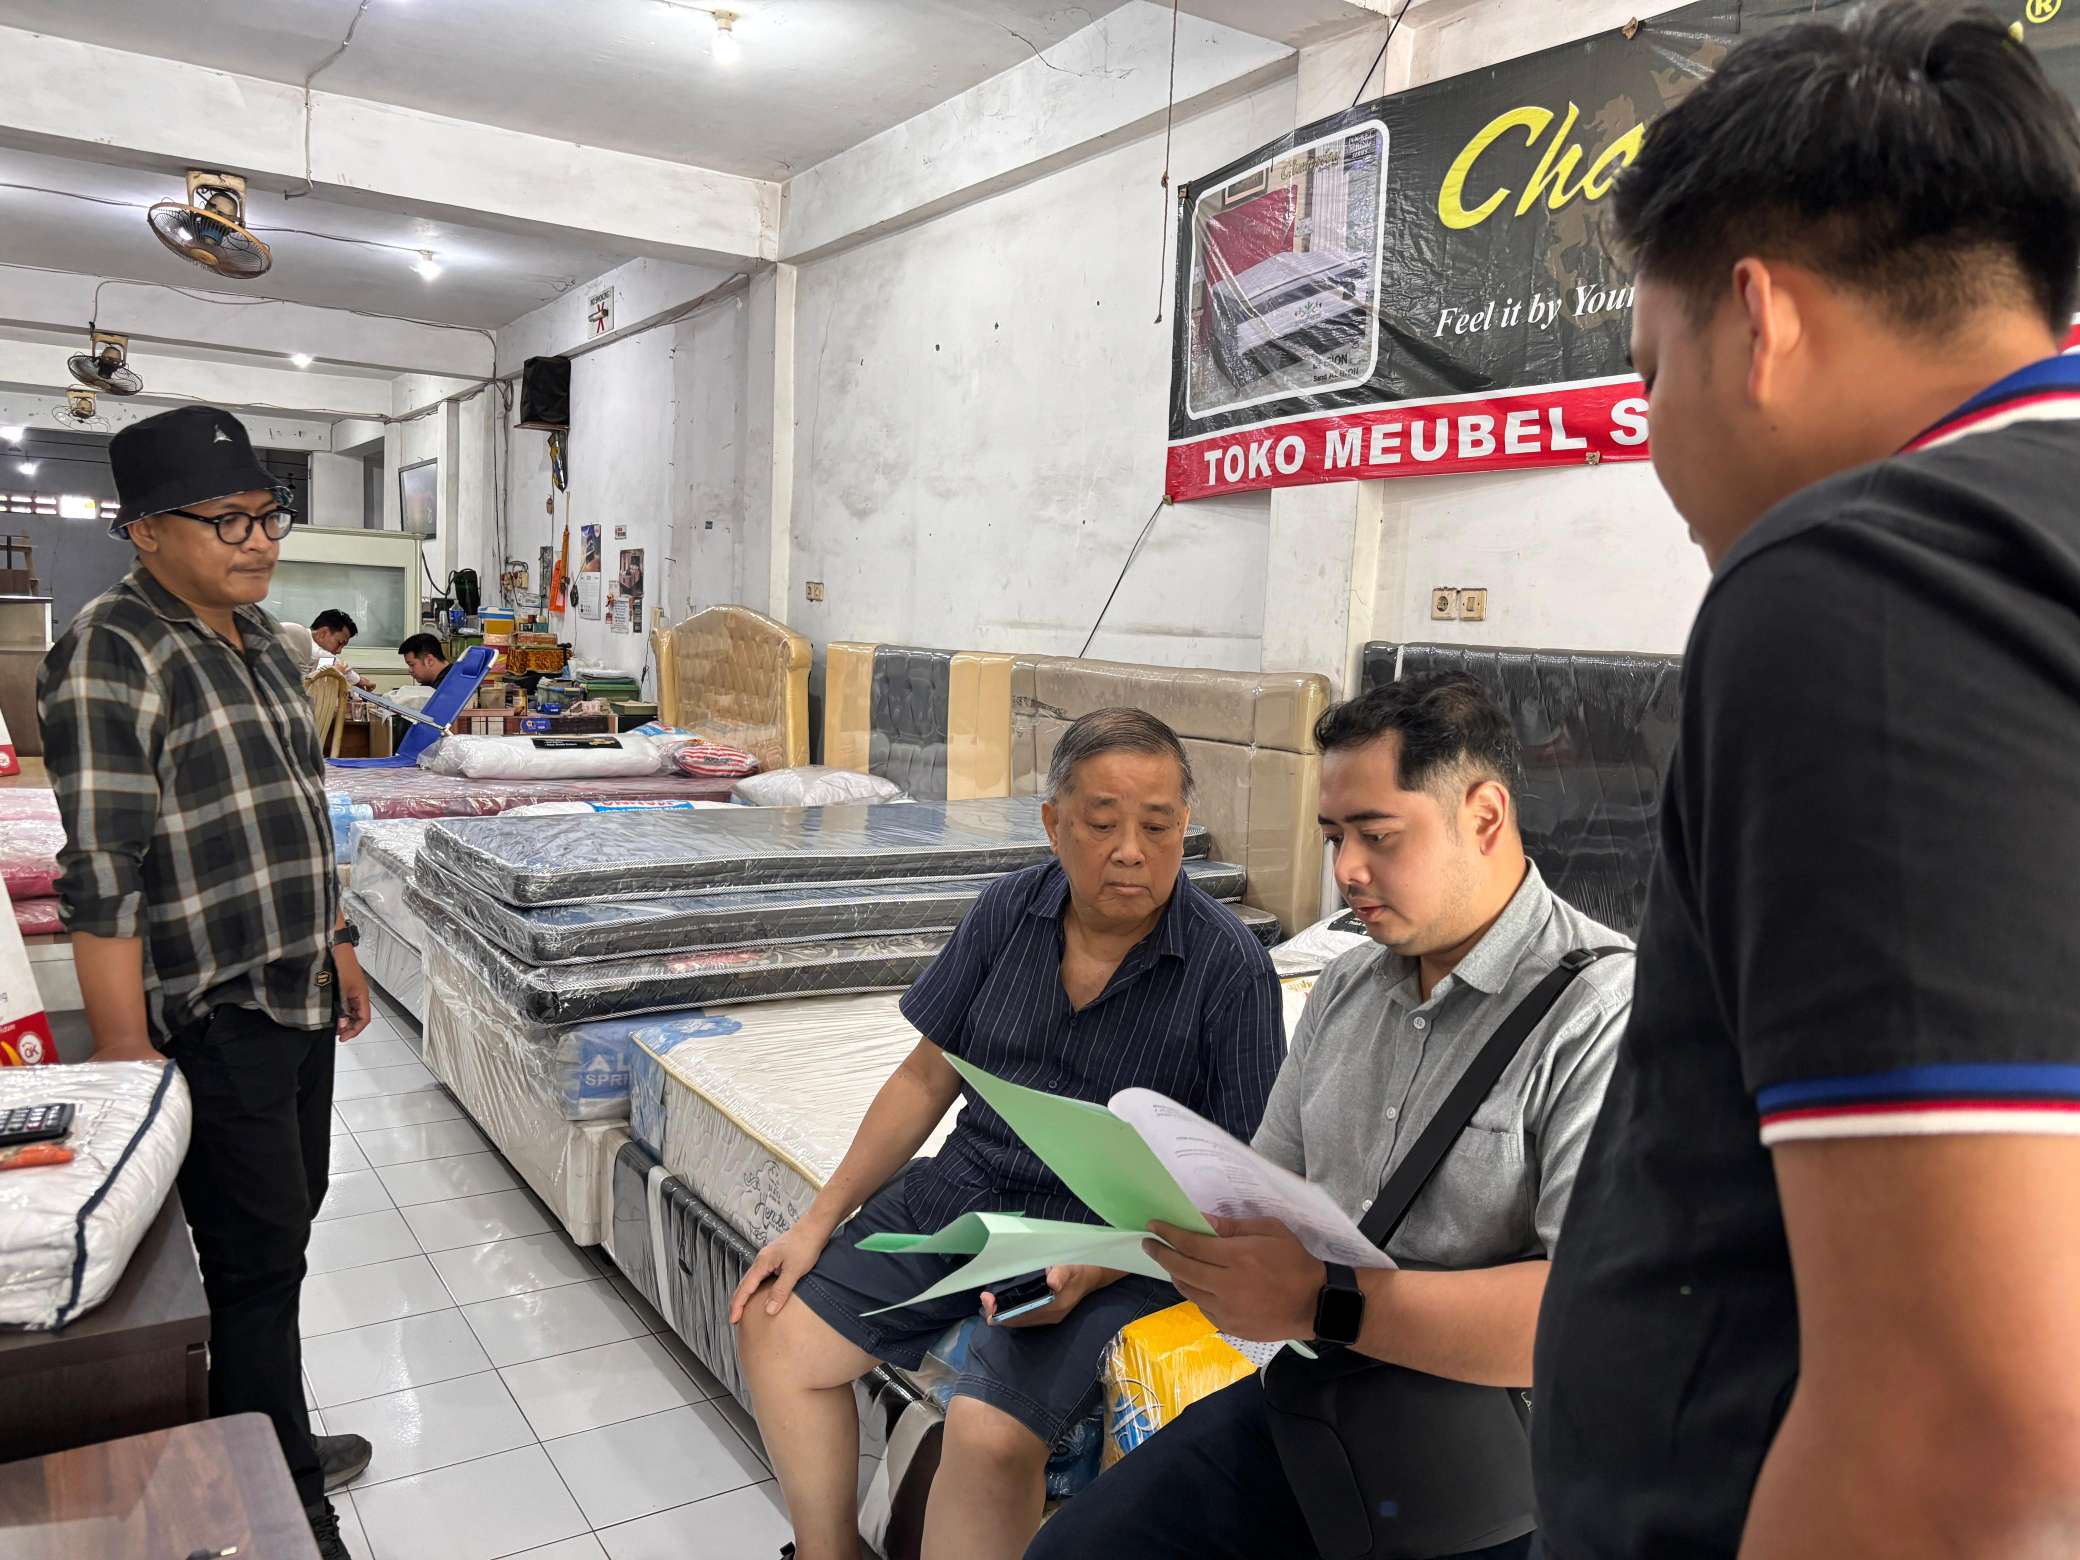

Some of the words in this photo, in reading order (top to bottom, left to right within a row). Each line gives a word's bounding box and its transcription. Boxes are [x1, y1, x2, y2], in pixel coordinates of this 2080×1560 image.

[1437, 101, 1647, 230] Cha
[1433, 301, 1496, 338] Feel
[1500, 298, 1522, 328] it
[1527, 293, 1562, 330] by
[1204, 435, 1306, 486] TOKO
[1323, 407, 1588, 471] MEUBEL
[1610, 398, 1649, 446] S
[585, 1073, 629, 1087] SPRI
